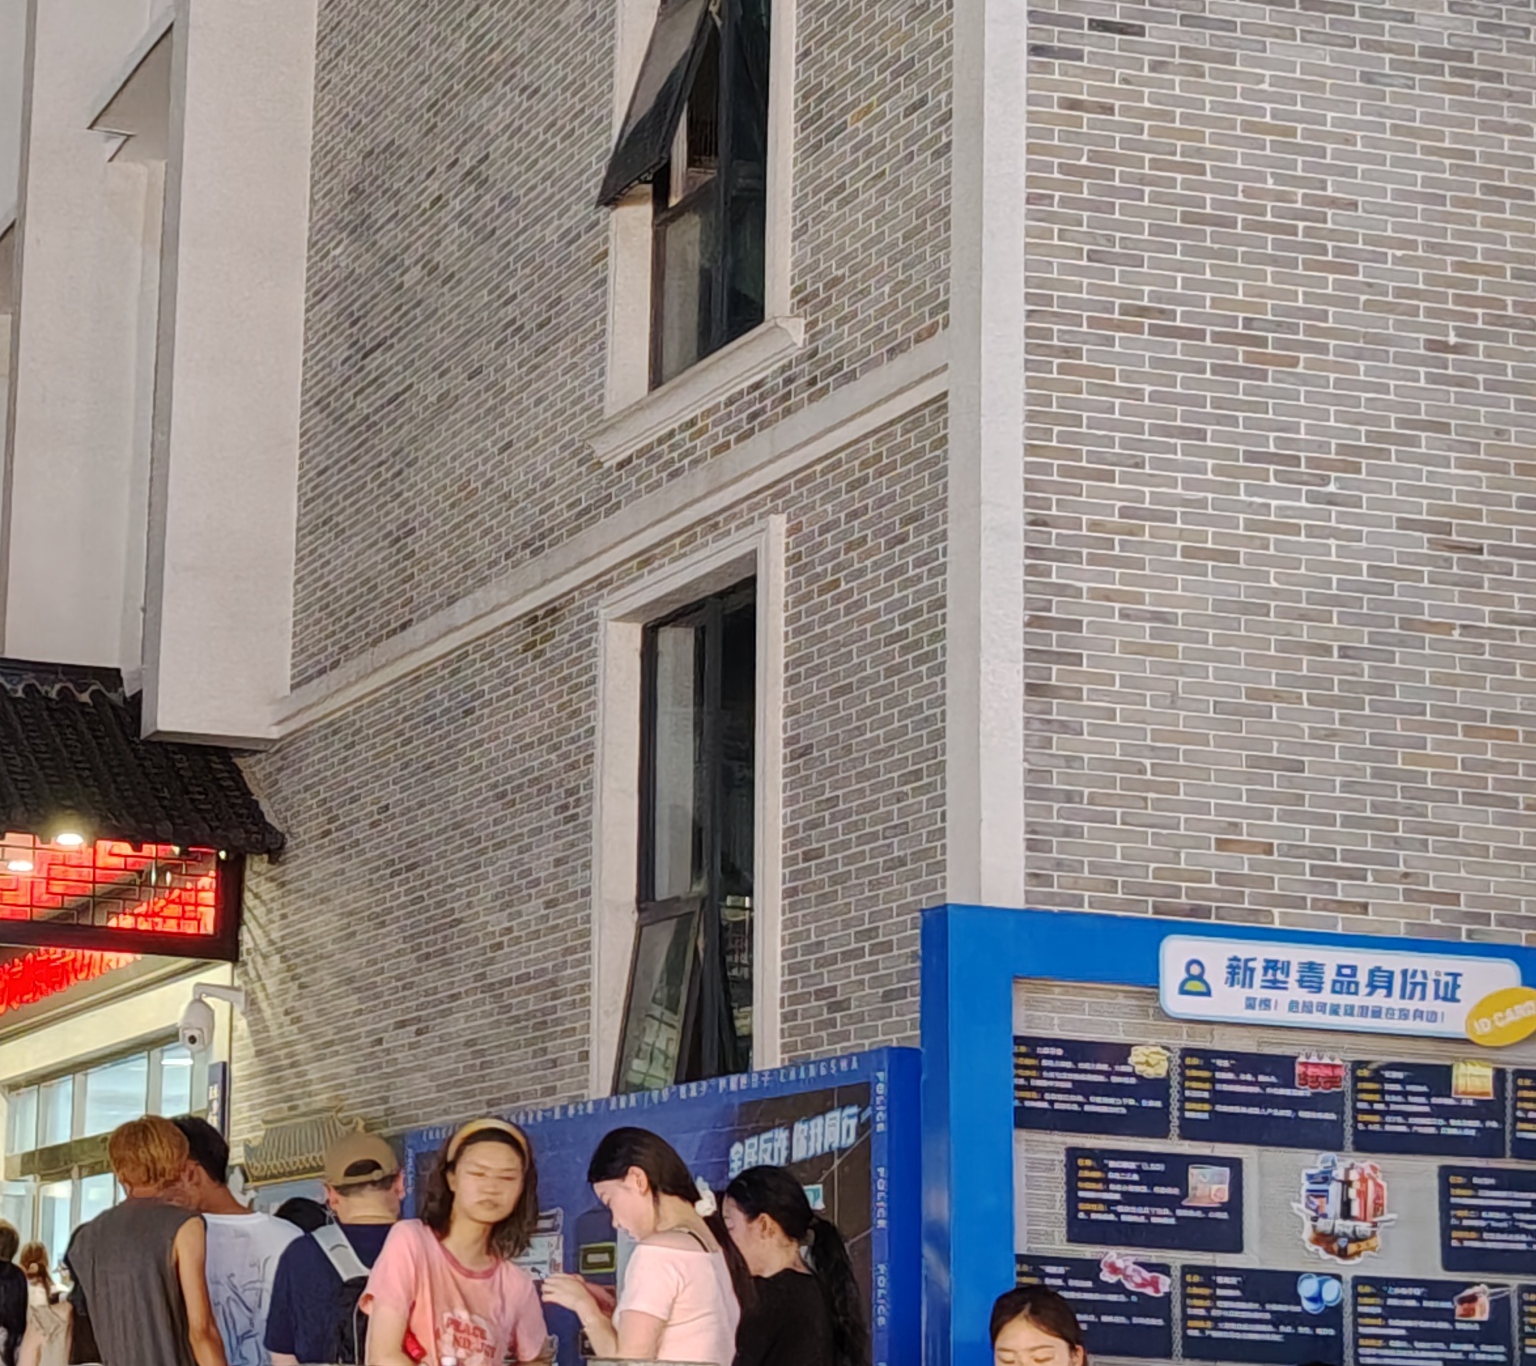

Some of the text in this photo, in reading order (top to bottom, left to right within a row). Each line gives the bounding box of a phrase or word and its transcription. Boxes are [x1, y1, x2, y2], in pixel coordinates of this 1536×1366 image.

[1224, 955, 1463, 1004] 新型毒品身份证
